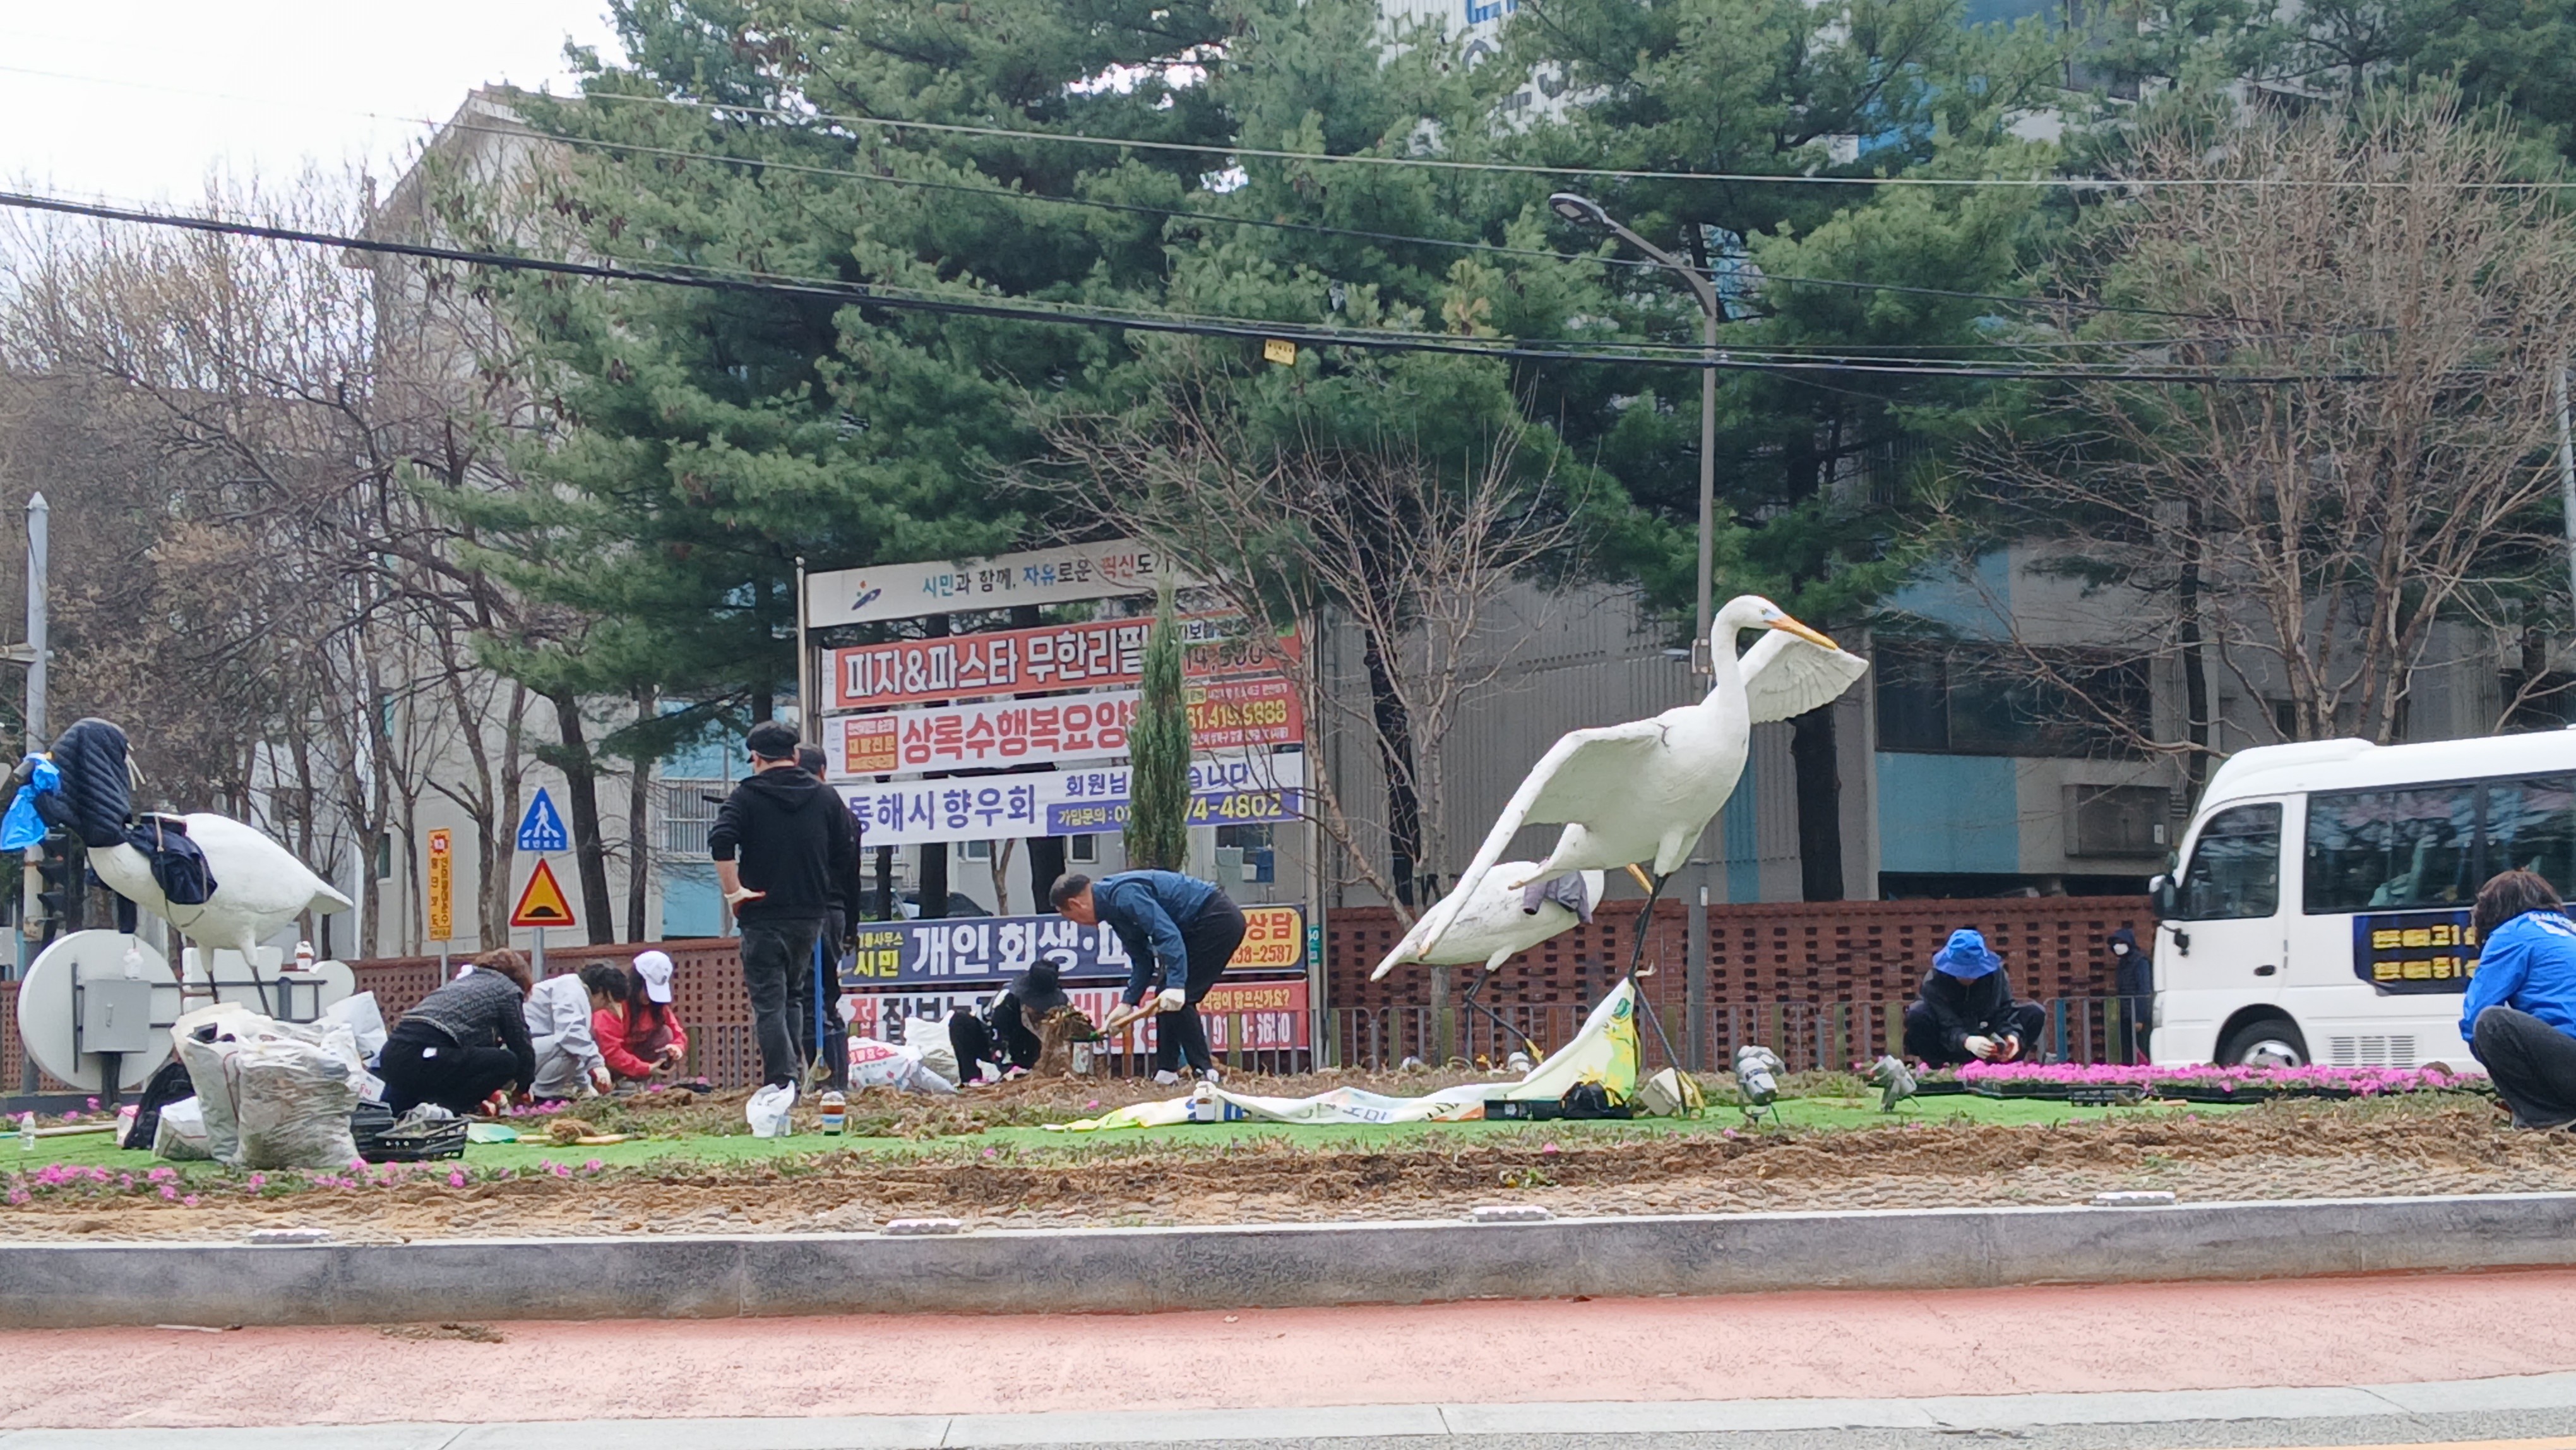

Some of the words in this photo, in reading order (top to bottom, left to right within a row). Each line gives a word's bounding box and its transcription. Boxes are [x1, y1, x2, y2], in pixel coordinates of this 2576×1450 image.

[922, 573, 972, 599] 시민과
[979, 569, 1017, 592] 함께,
[1022, 560, 1092, 587] 자유로운
[845, 638, 1018, 697] 피자&파스타
[1027, 625, 1149, 683] 무한리필
[1065, 771, 1127, 798] 회원님
[849, 790, 934, 833] 동해시
[943, 784, 1035, 829] 향우회
[1246, 912, 1293, 940] 상담
[853, 949, 899, 977] 시민
[912, 924, 990, 976] 개인
[1231, 944, 1293, 964] 38-2587
